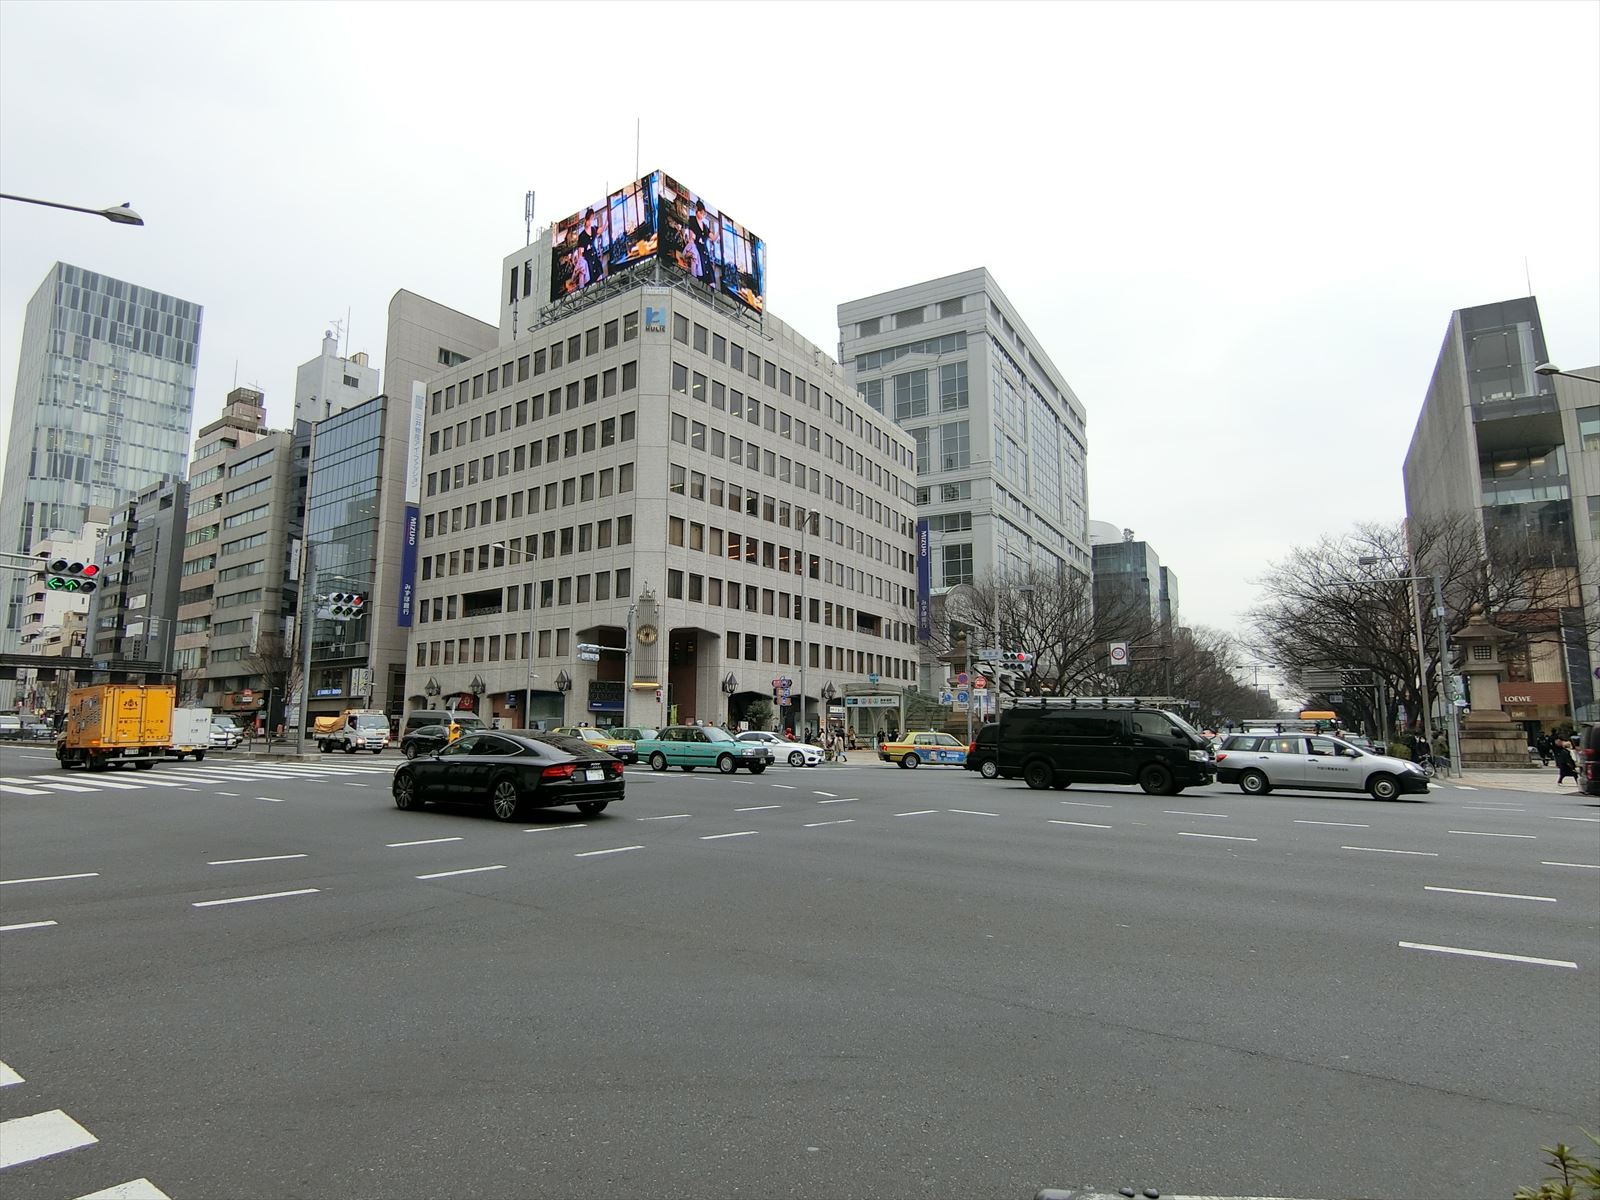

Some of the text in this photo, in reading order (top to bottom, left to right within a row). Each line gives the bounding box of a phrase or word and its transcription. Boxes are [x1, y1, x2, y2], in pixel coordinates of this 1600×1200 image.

[409, 516, 417, 545] MIZUHO
[402, 583, 411, 616] みずほ銀行
